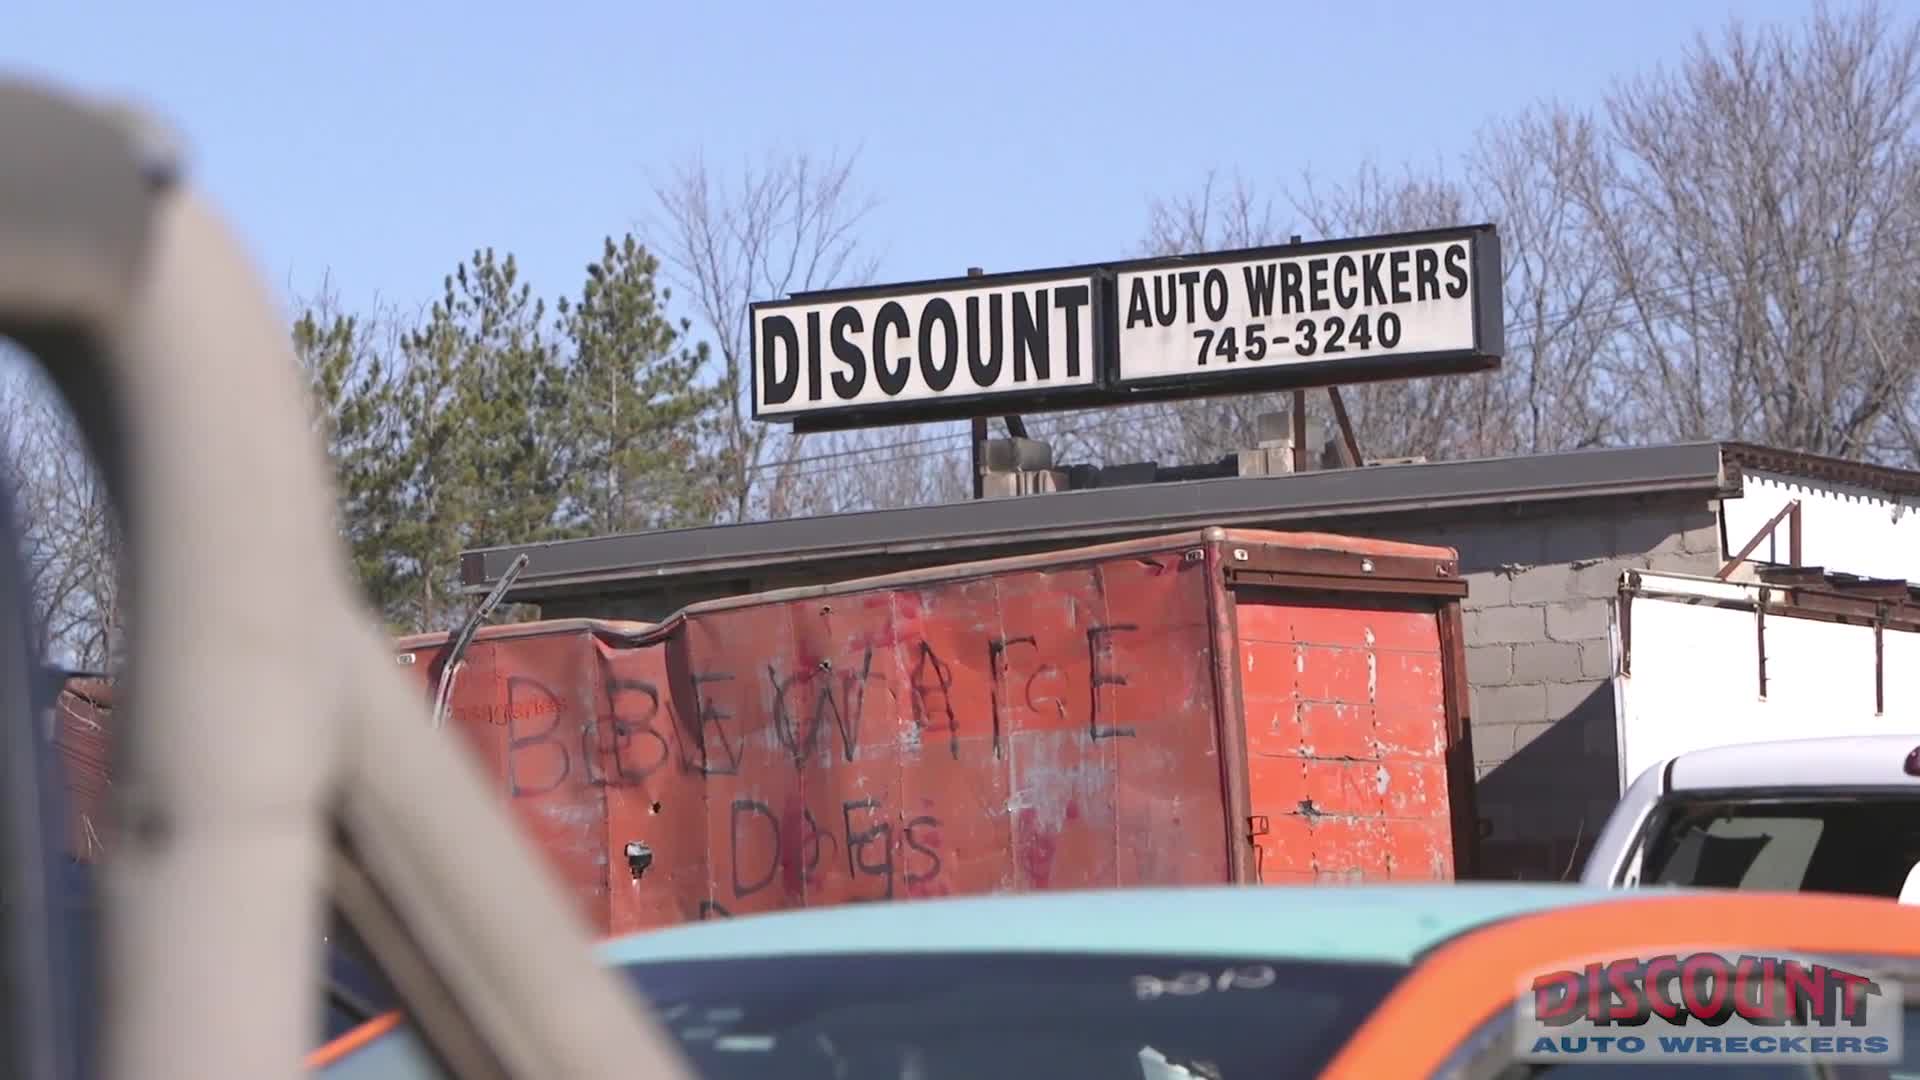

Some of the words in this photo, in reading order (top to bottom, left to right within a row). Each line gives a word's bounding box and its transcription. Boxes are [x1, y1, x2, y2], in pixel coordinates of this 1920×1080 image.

[1126, 268, 1229, 329] AUTO
[1243, 244, 1469, 318] WRECKERS
[761, 285, 1089, 406] DISCOUNT
[1193, 311, 1402, 366] 745-3240
